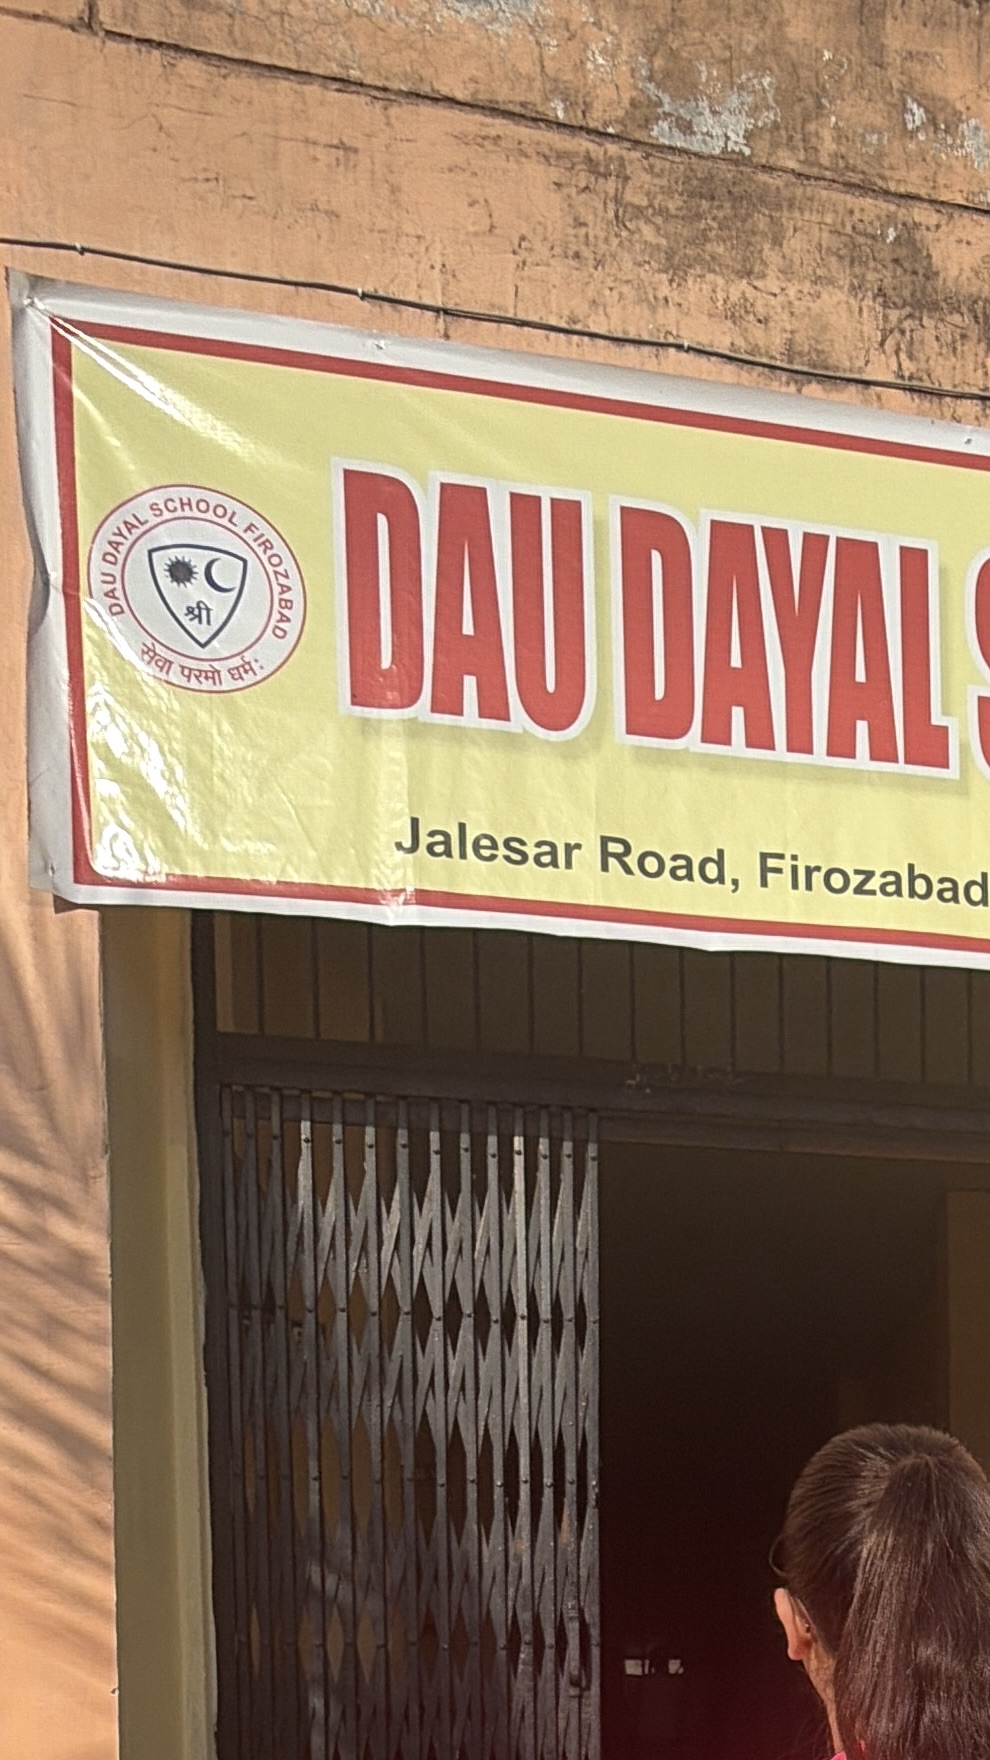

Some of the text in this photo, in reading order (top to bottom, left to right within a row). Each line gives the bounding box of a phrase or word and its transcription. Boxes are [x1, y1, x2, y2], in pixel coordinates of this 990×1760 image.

[101, 497, 294, 641] DAU DAYAL SCHOOL FIROZABAD
[184, 600, 214, 627] श्री
[343, 468, 588, 733] DAU
[620, 505, 950, 769] DAYAL
[140, 642, 175, 676] सेवा
[179, 663, 223, 687] परमो
[395, 816, 582, 871] Jalesar
[600, 835, 740, 894] Road,
